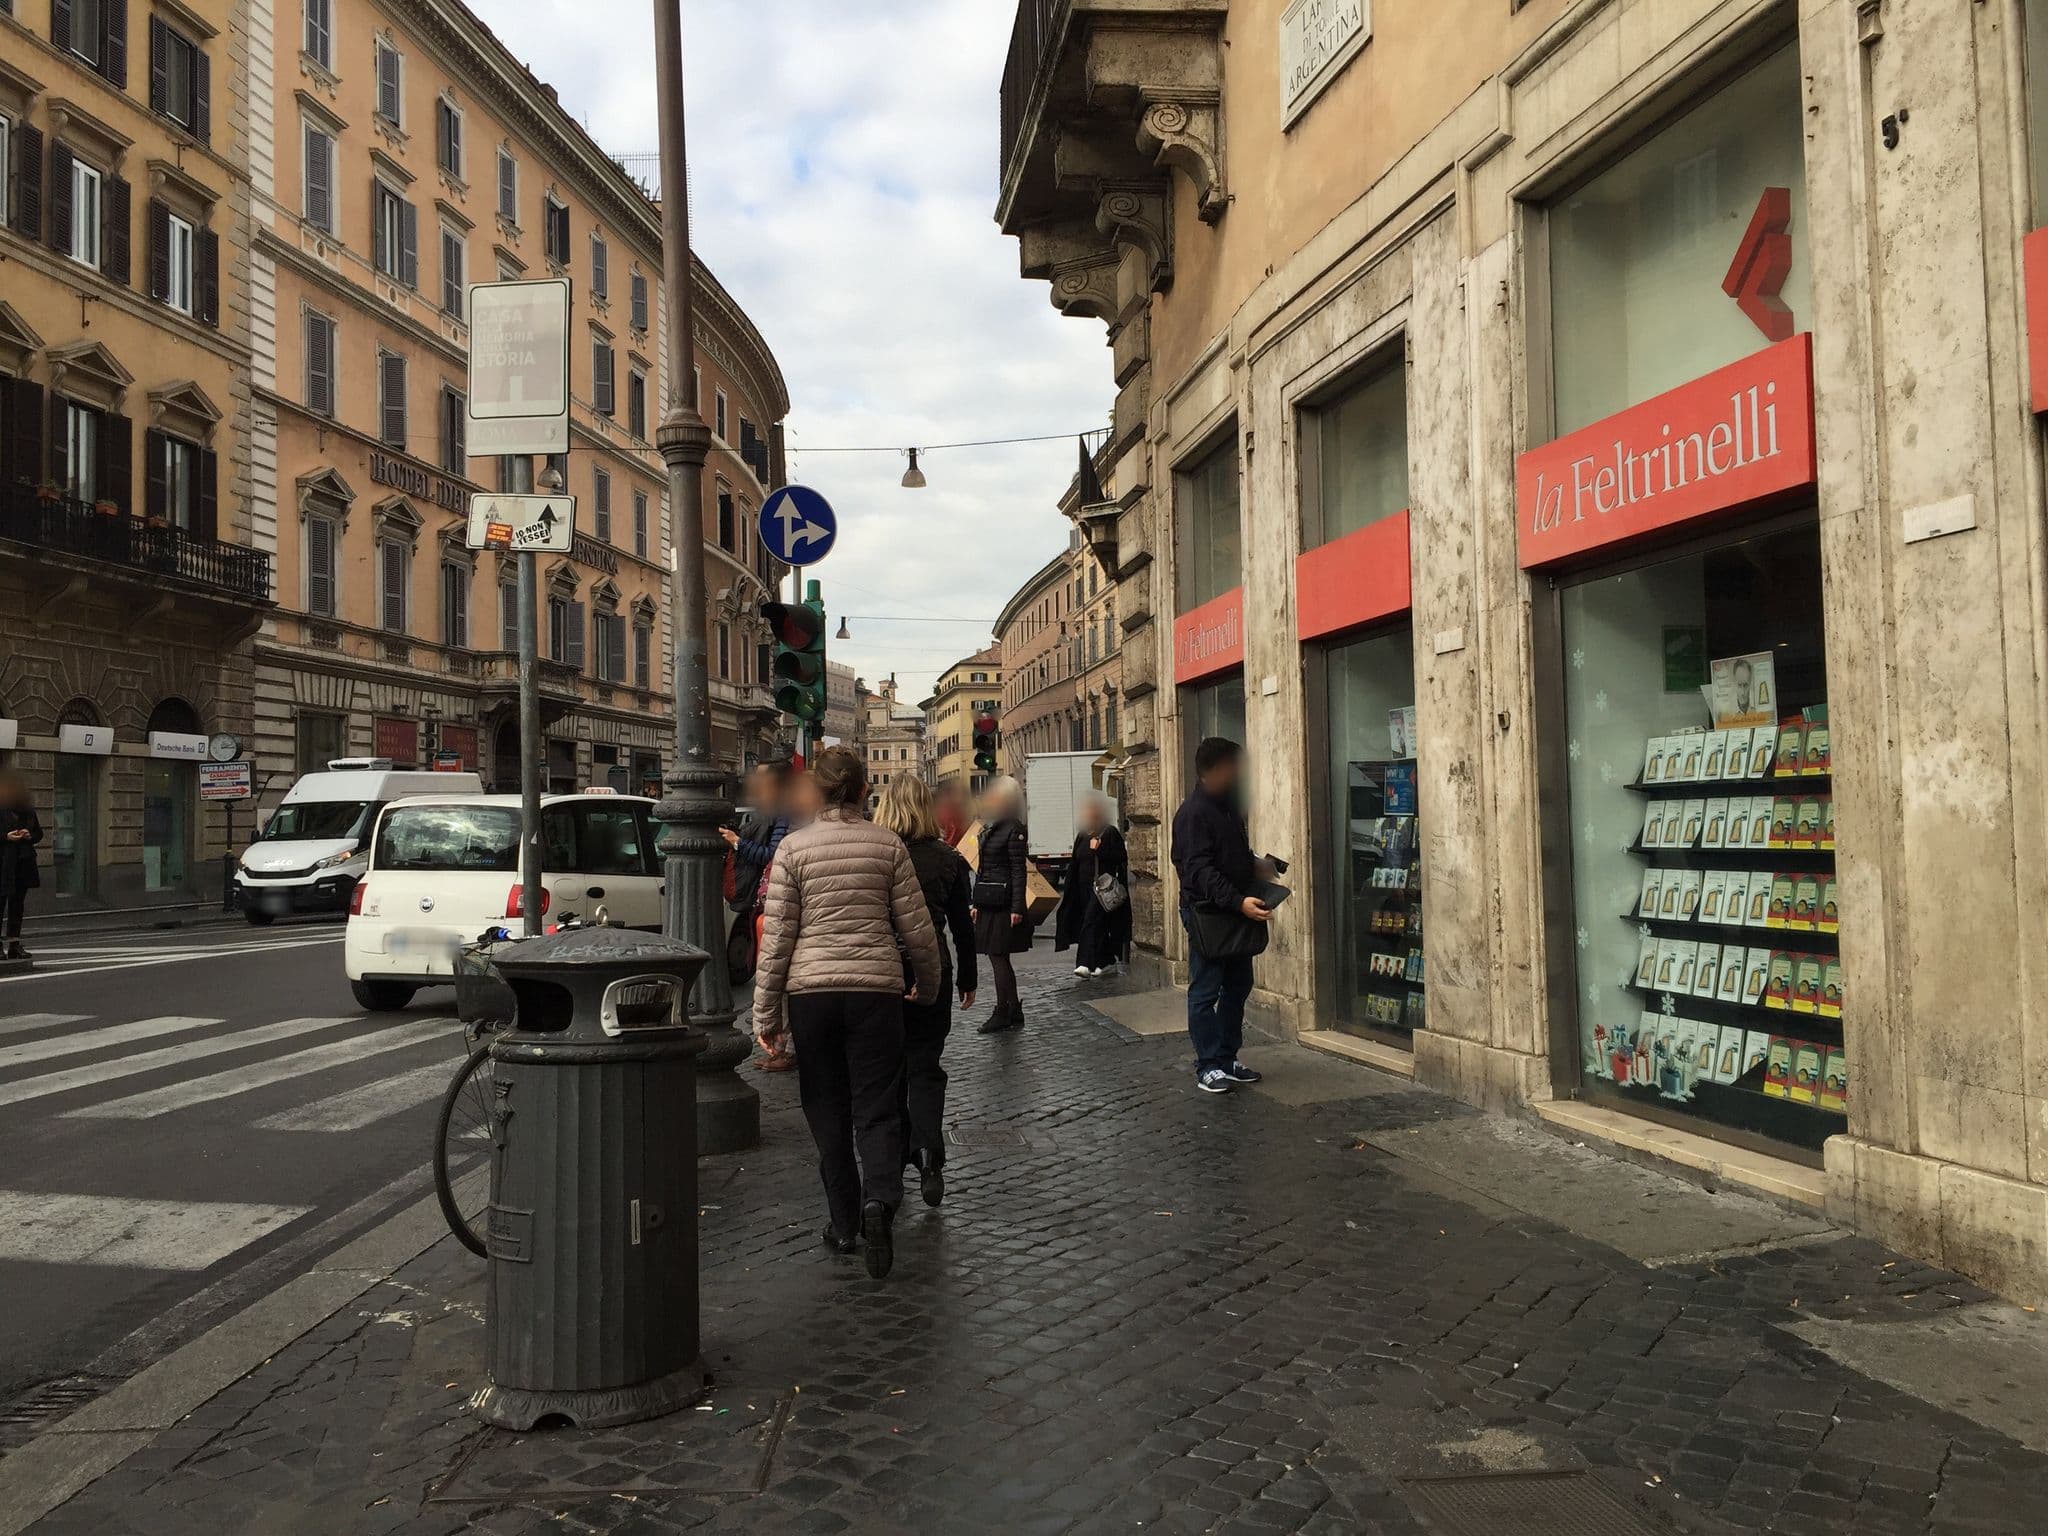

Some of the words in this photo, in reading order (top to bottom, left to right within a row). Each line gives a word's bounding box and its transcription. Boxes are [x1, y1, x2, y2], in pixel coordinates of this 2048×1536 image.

[1287, 4, 1359, 97] ARGENTINA
[475, 351, 536, 368] STORIA
[1533, 473, 1564, 535] la
[1571, 381, 1782, 523] Feltrinelli
[526, 522, 543, 534] NON
[1187, 608, 1238, 662] Feltrinelli
